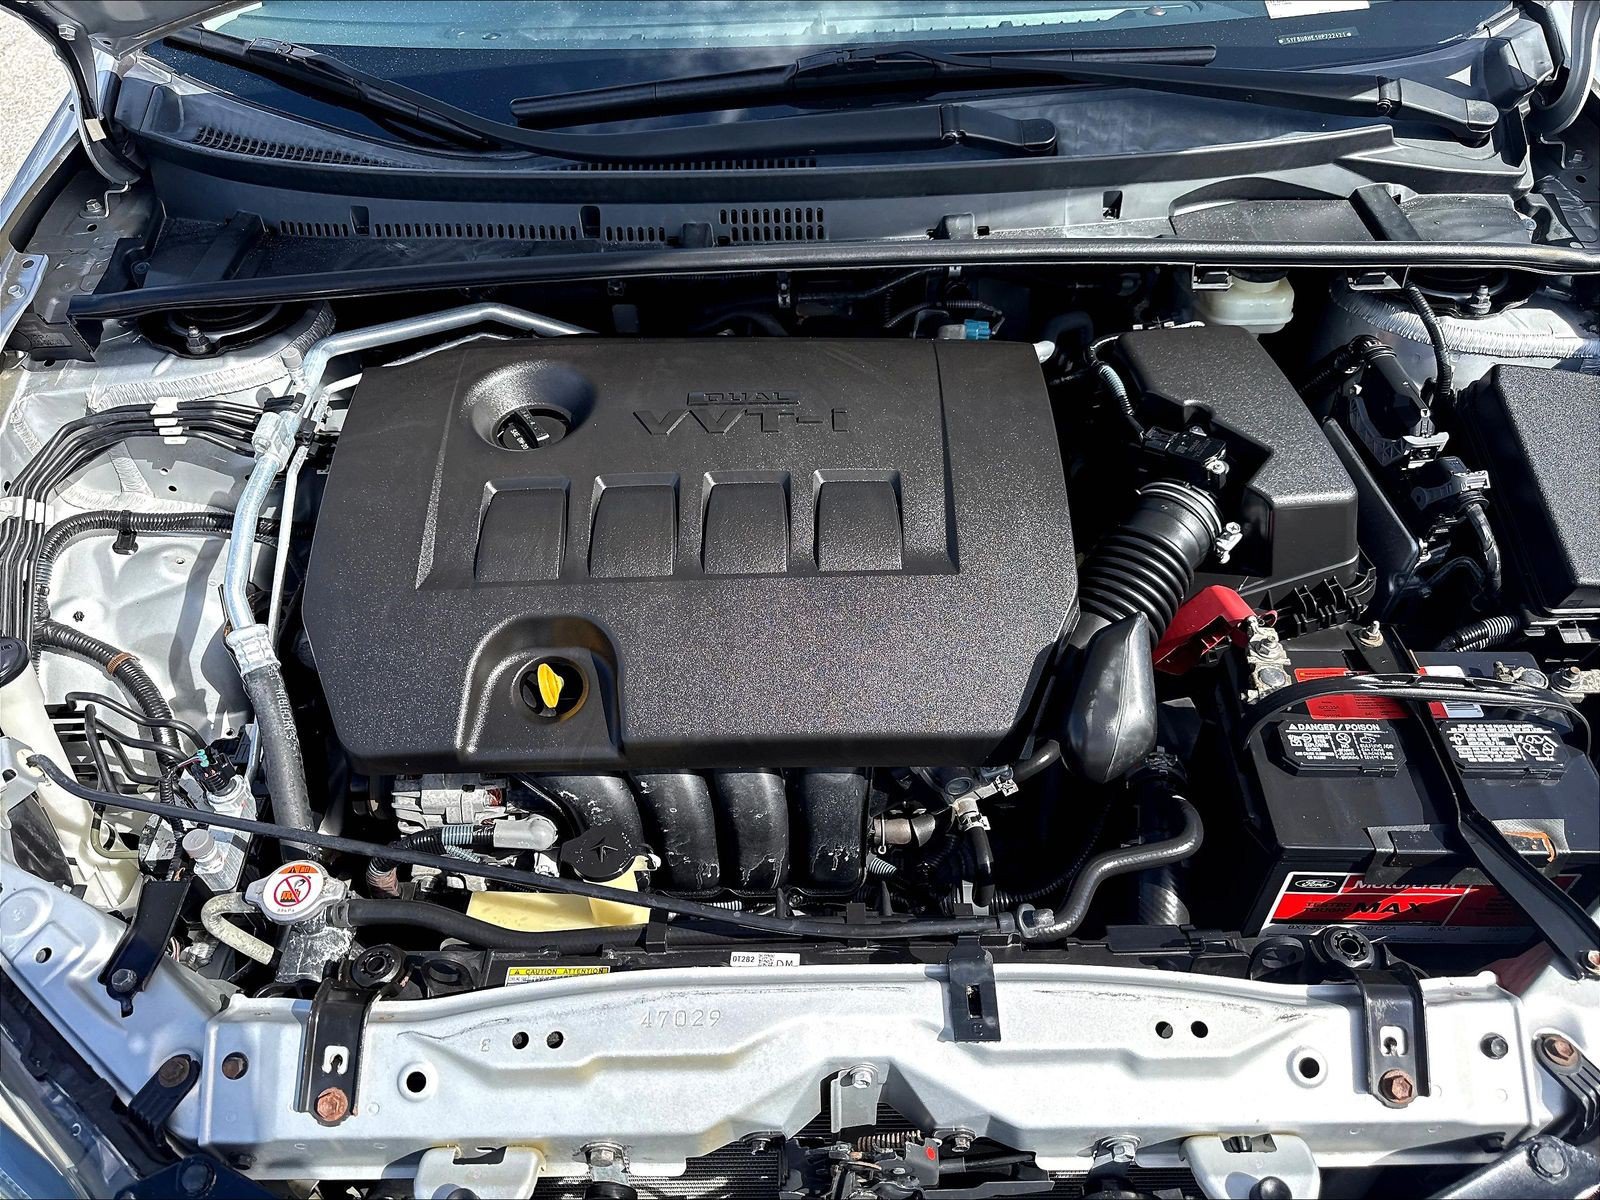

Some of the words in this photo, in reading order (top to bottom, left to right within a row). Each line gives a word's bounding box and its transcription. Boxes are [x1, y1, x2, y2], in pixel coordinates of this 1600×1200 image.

[703, 392, 791, 402] DUAL
[1298, 723, 1337, 731] DANGER
[1345, 723, 1380, 731] POISON
[1301, 879, 1330, 888] Ford
[1353, 901, 1424, 914] MAX
[525, 968, 557, 976] CAUTION
[563, 967, 605, 975] ATTENTION
[640, 1009, 721, 1029] 47029
